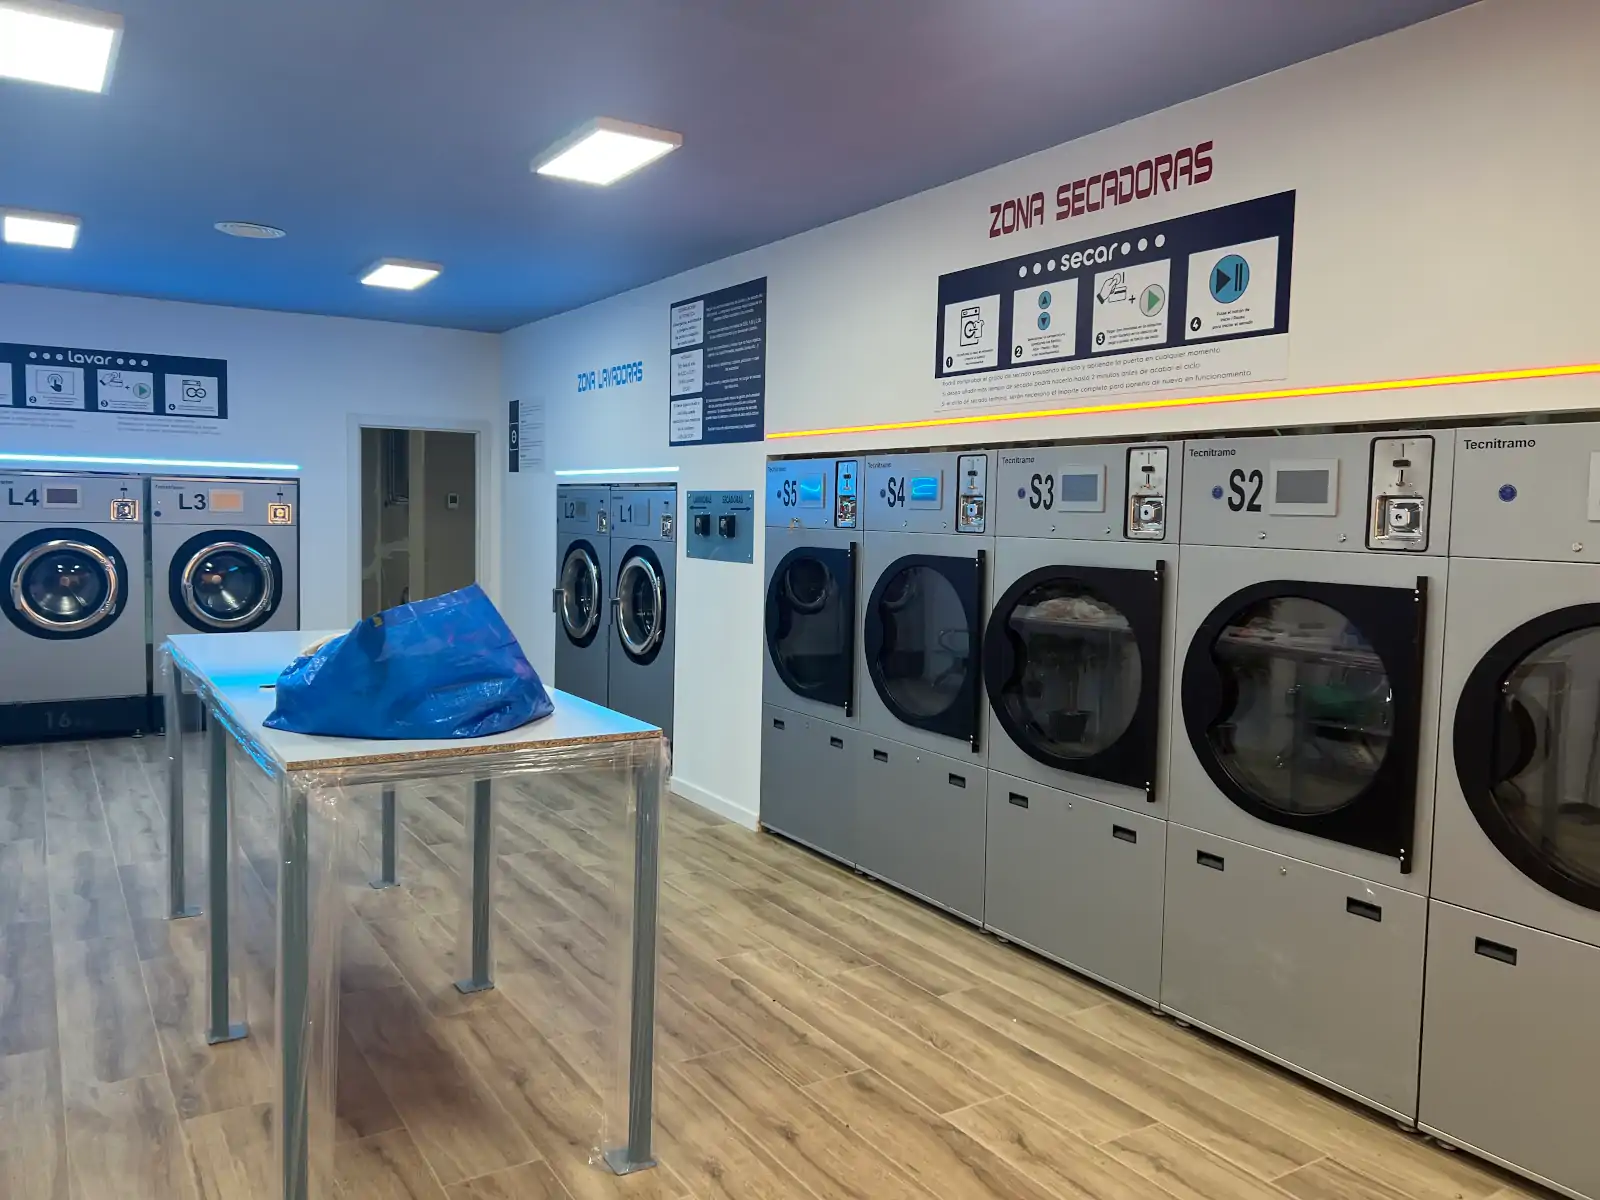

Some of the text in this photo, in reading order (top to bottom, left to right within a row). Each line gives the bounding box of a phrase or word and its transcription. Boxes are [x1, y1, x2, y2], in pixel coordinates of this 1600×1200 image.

[990, 140, 1214, 238] ZONA SECADORAS
[1060, 242, 1118, 271] secar
[68, 350, 112, 365] lavar
[1122, 357, 1144, 366] puerta
[1187, 347, 1220, 357] momento
[578, 361, 642, 392] ZONA LAVADORAS
[1195, 370, 1252, 380] funcionamiento
[1189, 448, 1236, 457] Tecnitramo
[1464, 438, 1536, 450] Tecnitramo
[9, 488, 39, 506] L4
[783, 480, 797, 507] S5
[887, 477, 905, 508] S4
[1030, 474, 1054, 510] S3
[1228, 468, 1263, 512] S2
[179, 493, 206, 510] L3
[565, 502, 574, 518] L2
[620, 504, 632, 522] L1
[44, 711, 72, 730] 16
